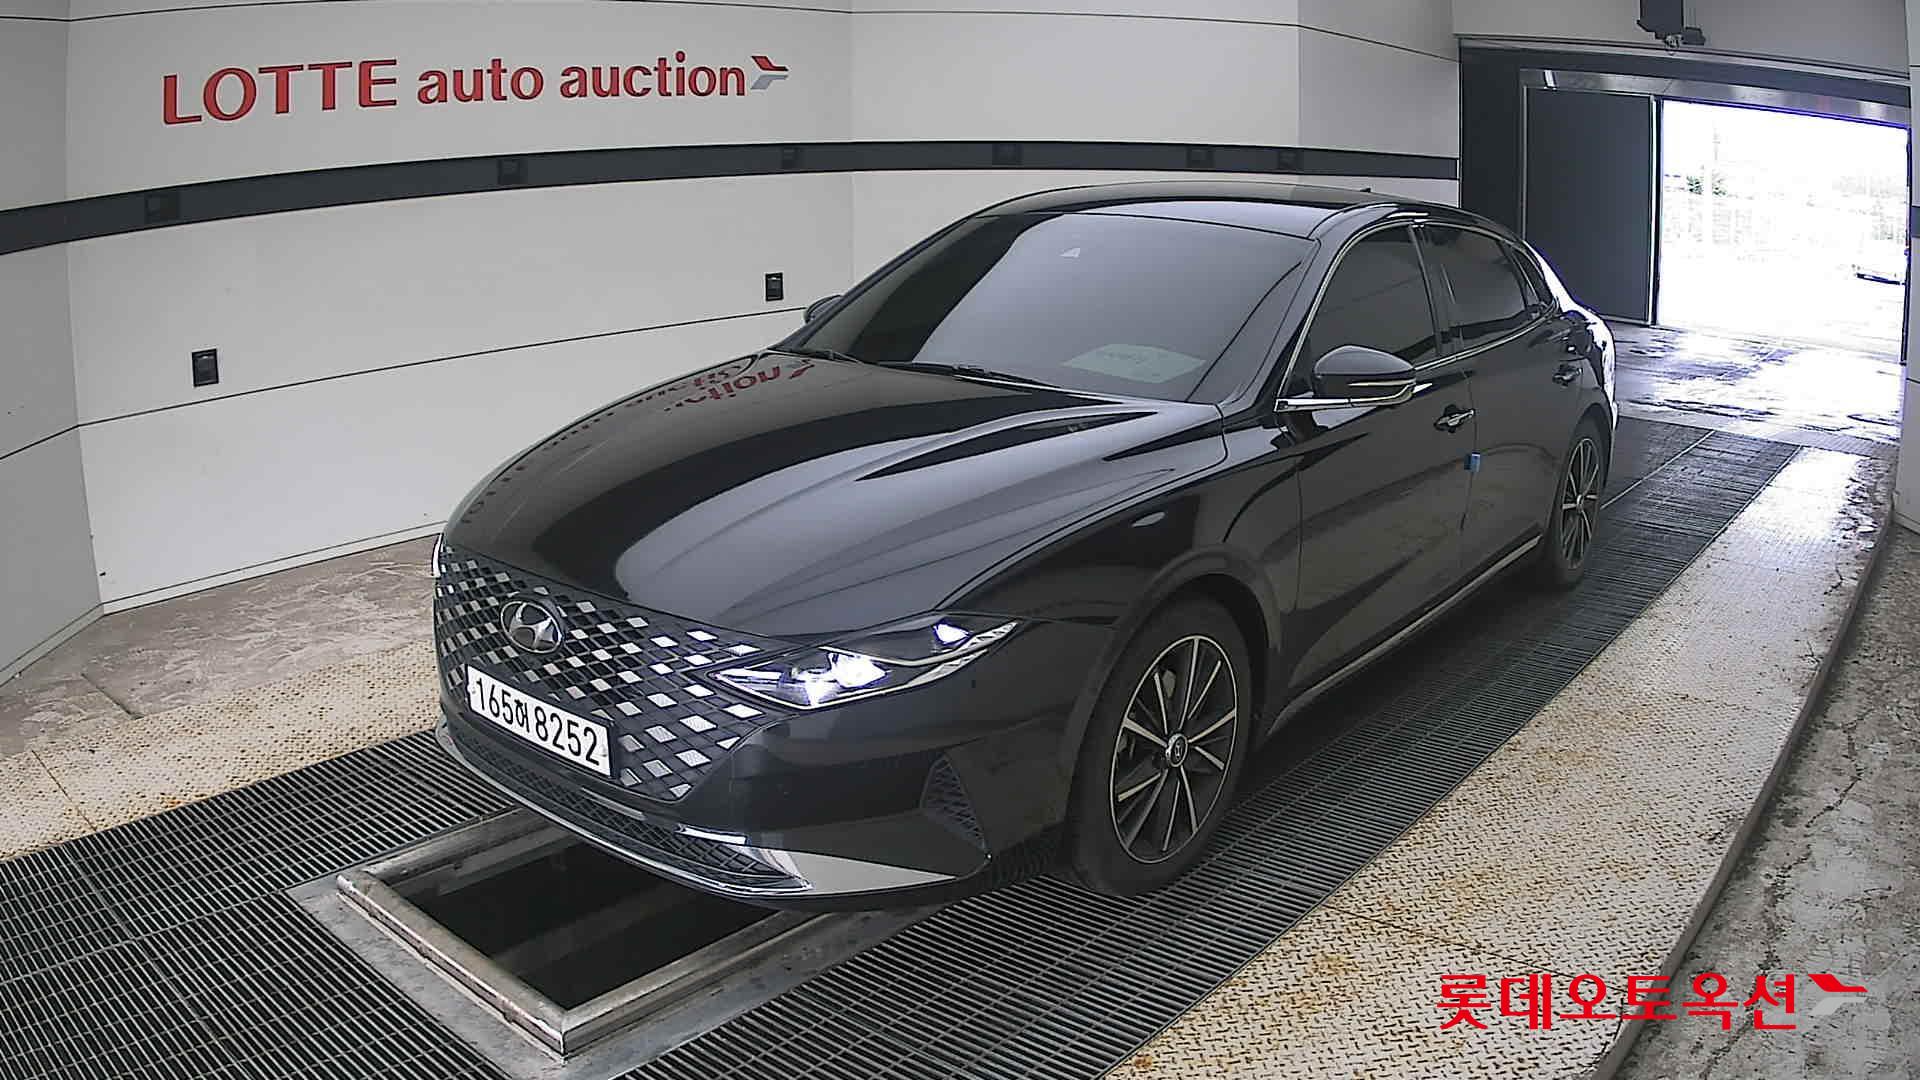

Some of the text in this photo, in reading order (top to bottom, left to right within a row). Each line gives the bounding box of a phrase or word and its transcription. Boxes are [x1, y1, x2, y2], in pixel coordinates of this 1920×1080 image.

[163, 51, 746, 125] LOTTE auto auction
